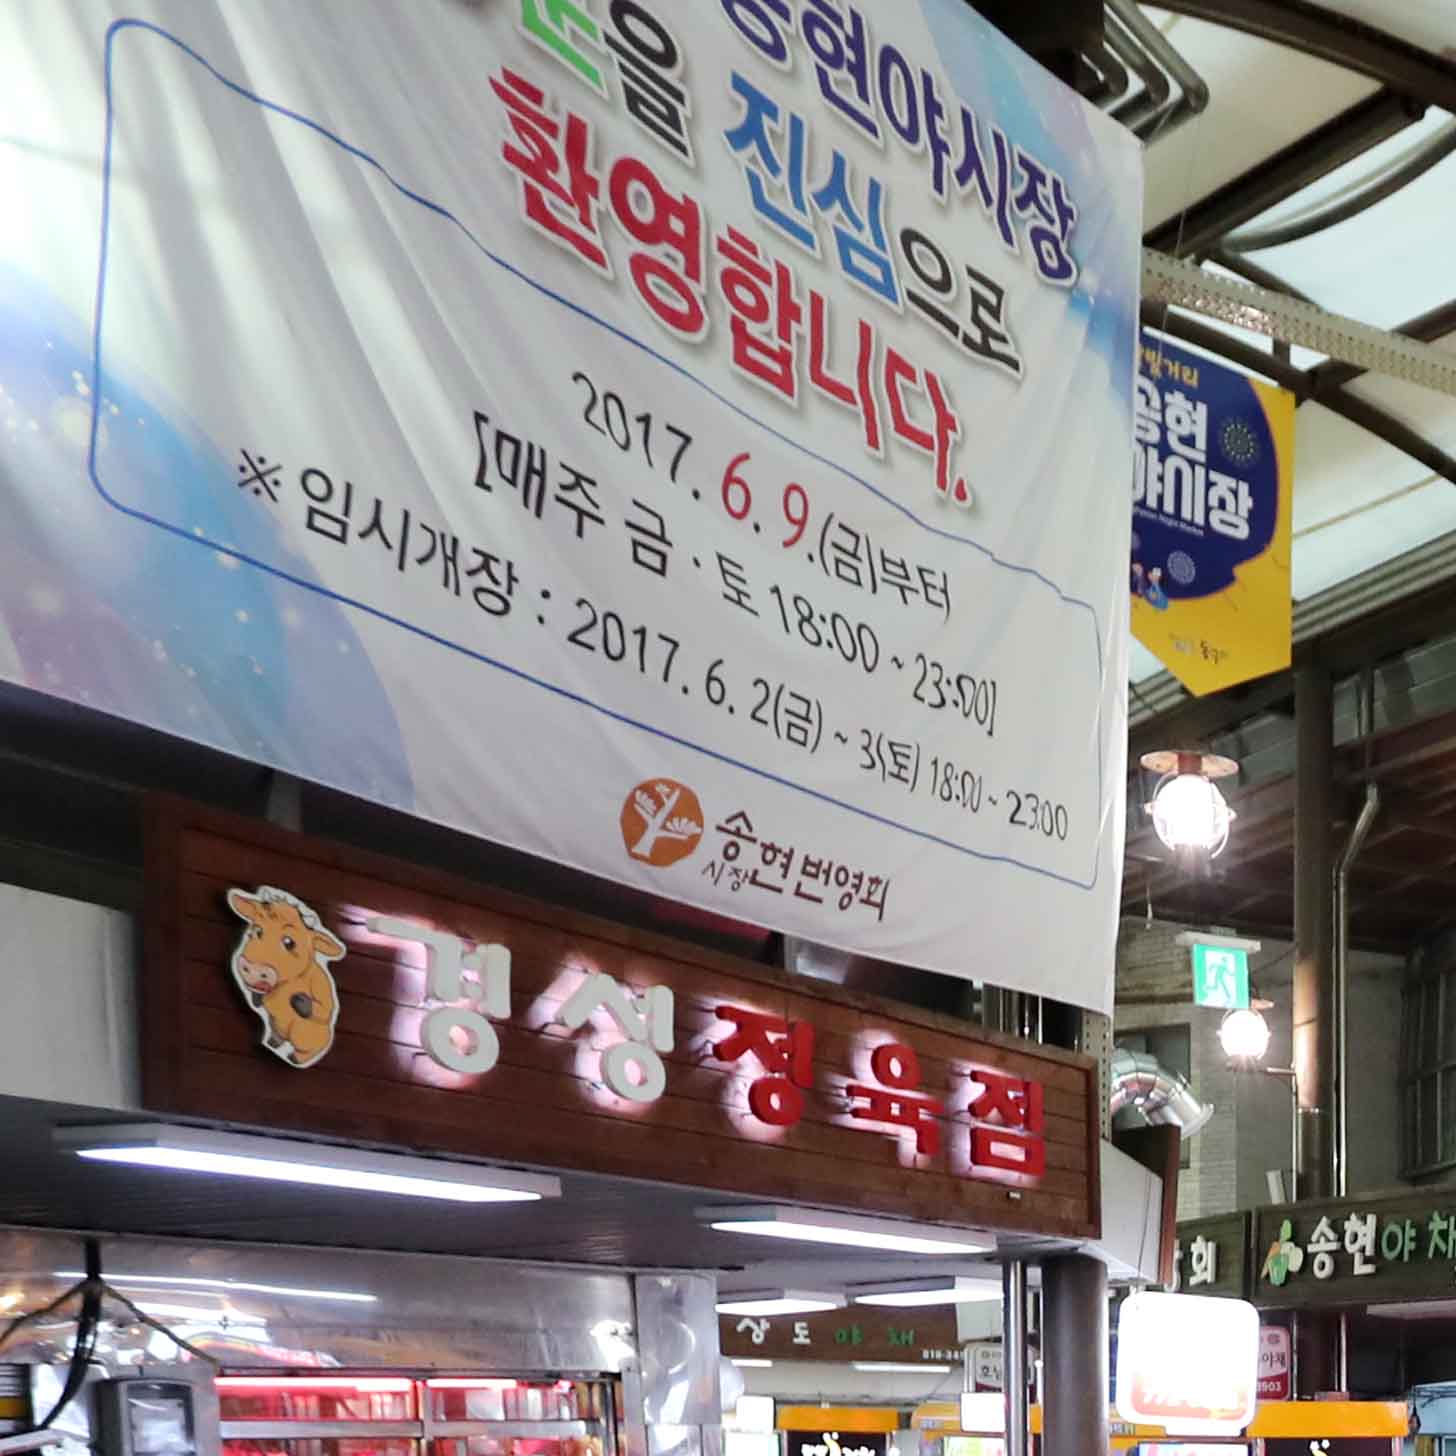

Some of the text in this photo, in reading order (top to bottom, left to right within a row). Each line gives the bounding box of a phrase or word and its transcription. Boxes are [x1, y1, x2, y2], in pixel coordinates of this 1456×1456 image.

[488, 67, 968, 503] 환영합니다.
[724, 71, 1022, 373] 진심으로
[571, 371, 701, 500] 2017.
[300, 466, 519, 617] 임시개장
[566, 597, 689, 695] 2017.
